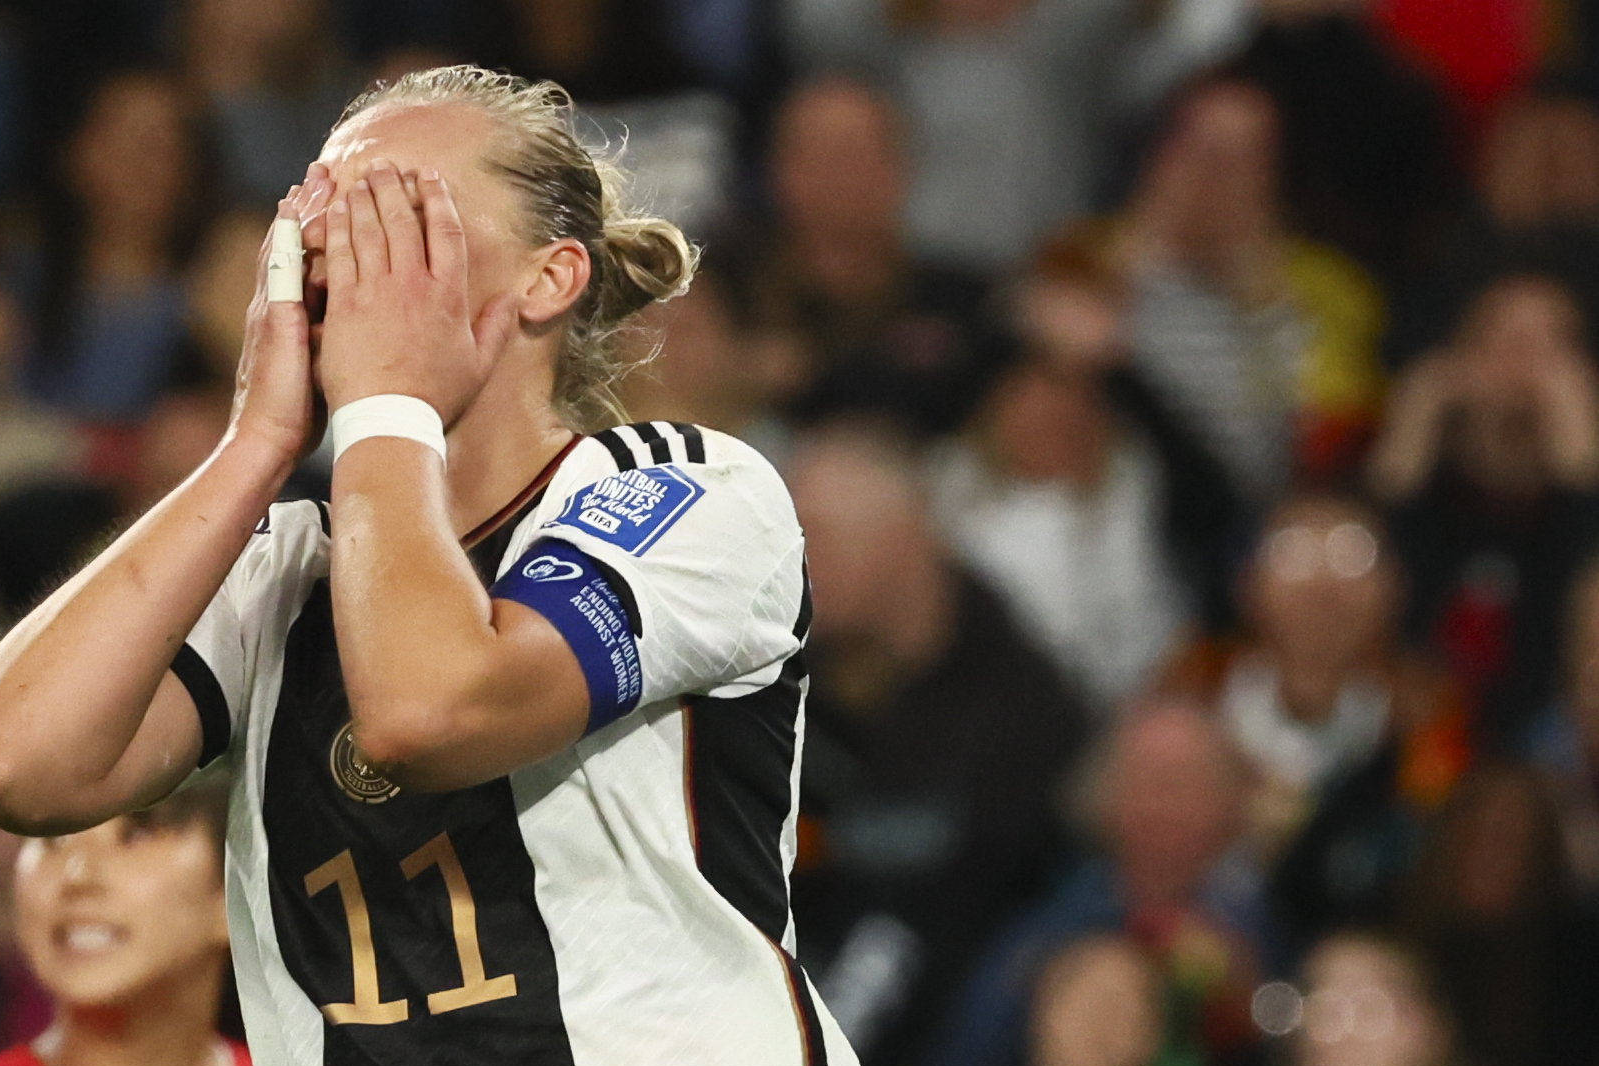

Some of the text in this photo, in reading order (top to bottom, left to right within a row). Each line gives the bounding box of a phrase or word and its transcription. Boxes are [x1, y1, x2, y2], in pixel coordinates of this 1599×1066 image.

[592, 476, 661, 511] UNITES
[618, 468, 669, 498] OTBALL
[580, 493, 652, 527] the World
[586, 511, 612, 529] FIFA
[579, 585, 622, 633] ENDING
[569, 594, 629, 704] AGAINST WOMEN
[303, 830, 518, 1026] 11
